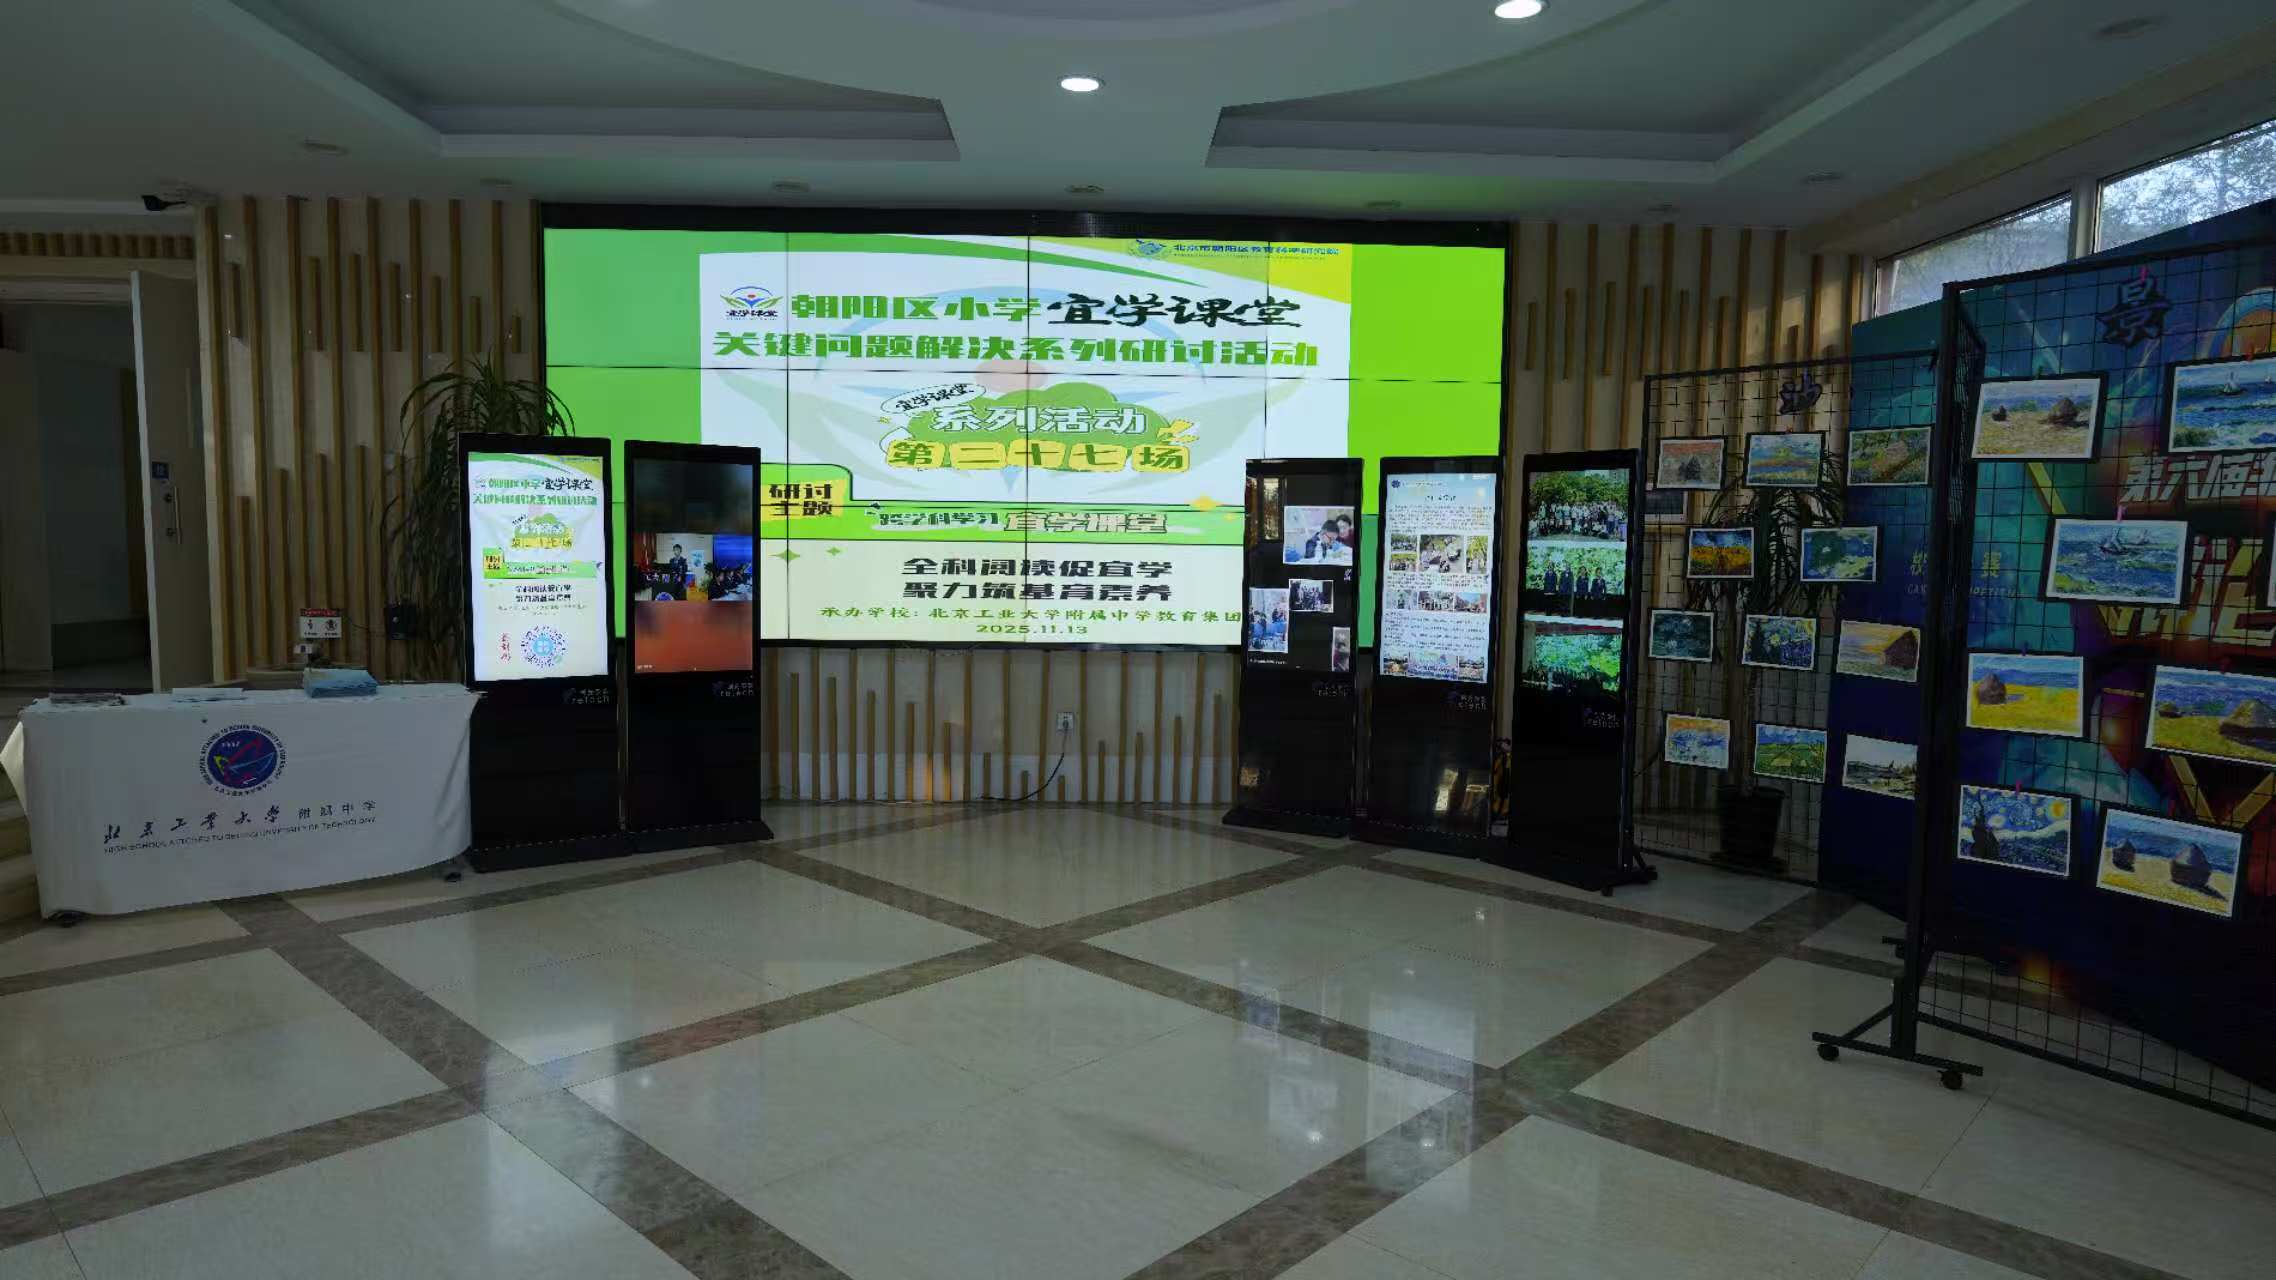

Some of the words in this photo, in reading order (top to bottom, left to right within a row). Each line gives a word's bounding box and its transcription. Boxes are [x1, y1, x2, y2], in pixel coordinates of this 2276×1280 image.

[712, 331, 1319, 368] 关键问题解决系列研讨活动
[895, 383, 975, 412] 宜学课堂
[930, 405, 1147, 434] 系列活动
[887, 440, 1184, 470] 第二十七场
[769, 484, 832, 500] 研讨
[769, 500, 832, 517] 主题
[902, 557, 1173, 579] 全科阅读促宜学
[902, 582, 1173, 602] 聚力筑基育素养
[976, 624, 1088, 635] 2025.11.13
